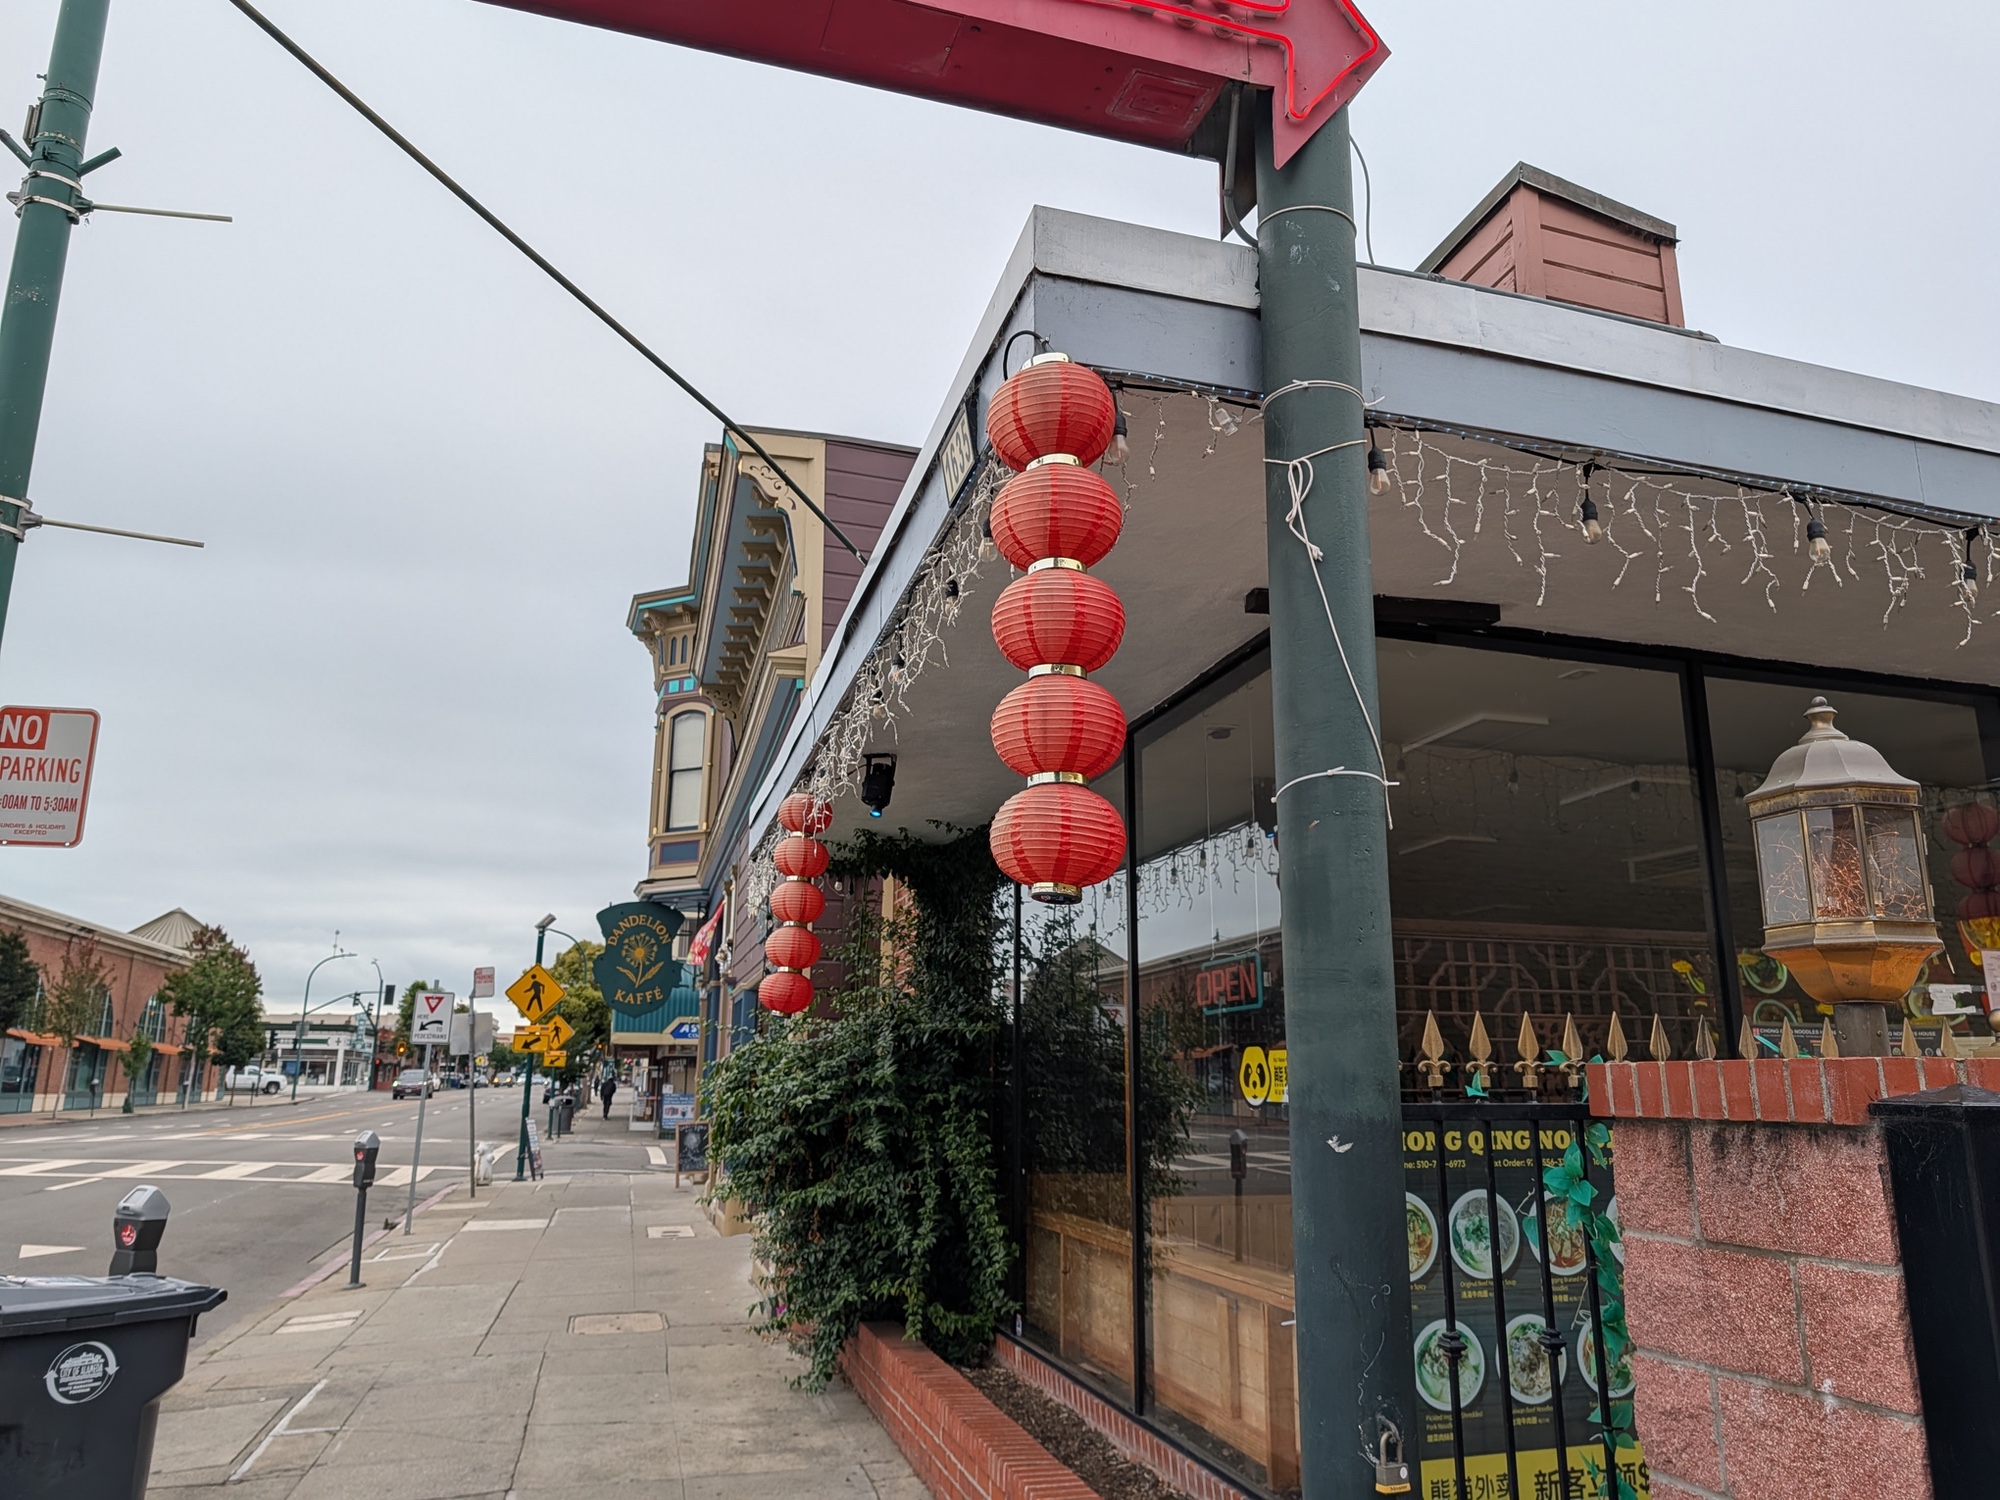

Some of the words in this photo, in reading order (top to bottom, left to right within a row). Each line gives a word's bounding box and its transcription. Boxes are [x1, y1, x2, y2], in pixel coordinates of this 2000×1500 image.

[945, 418, 971, 493] 1635
[0, 714, 43, 745] NO
[0, 756, 82, 784] PARKING
[31, 796, 41, 811] TO
[44, 796, 78, 813] 5:30AM
[607, 914, 671, 947] DANDELION
[614, 986, 664, 1005] KAFFÉ
[1196, 962, 1257, 1006] OPEN
[1502, 1158, 1525, 1167] Order:
